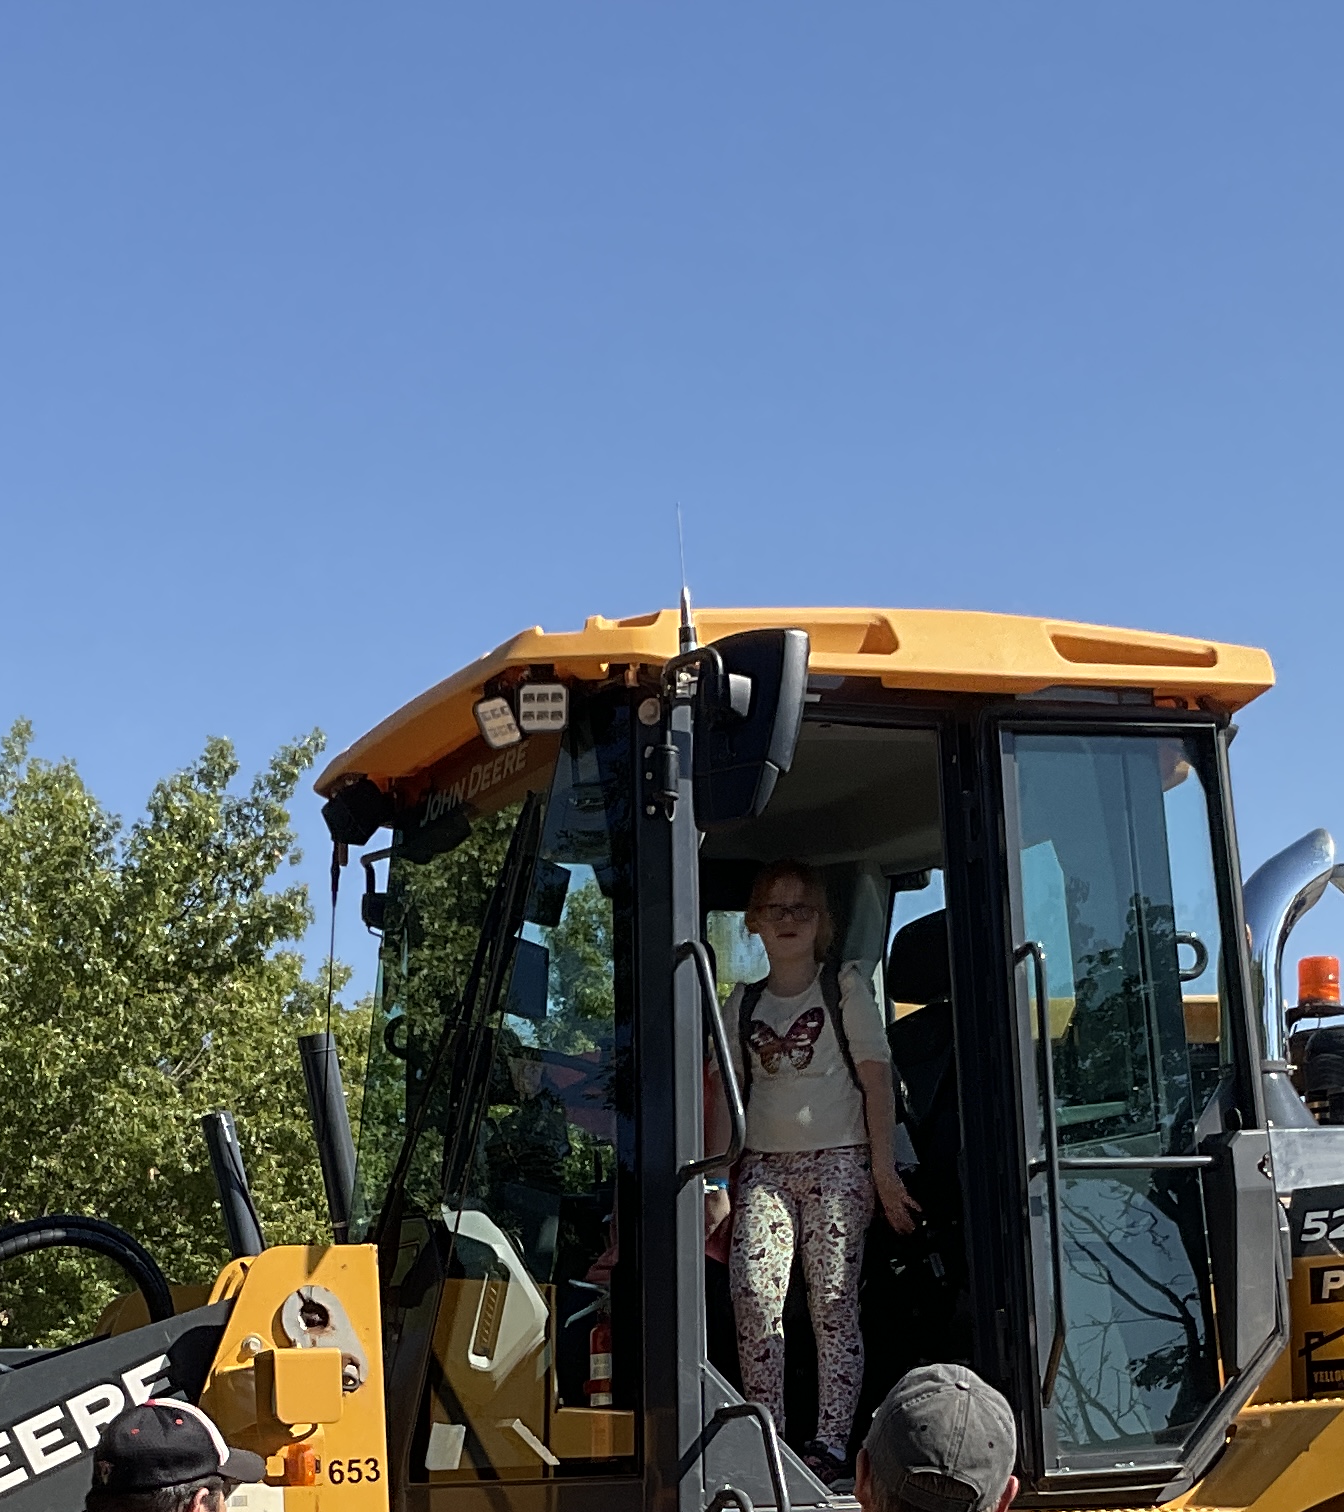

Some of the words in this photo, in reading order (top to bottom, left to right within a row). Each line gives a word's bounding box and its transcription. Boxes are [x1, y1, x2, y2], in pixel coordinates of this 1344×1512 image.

[419, 777, 466, 828] JOHN
[467, 740, 530, 800] DEERE
[328, 1457, 381, 1485] 653
